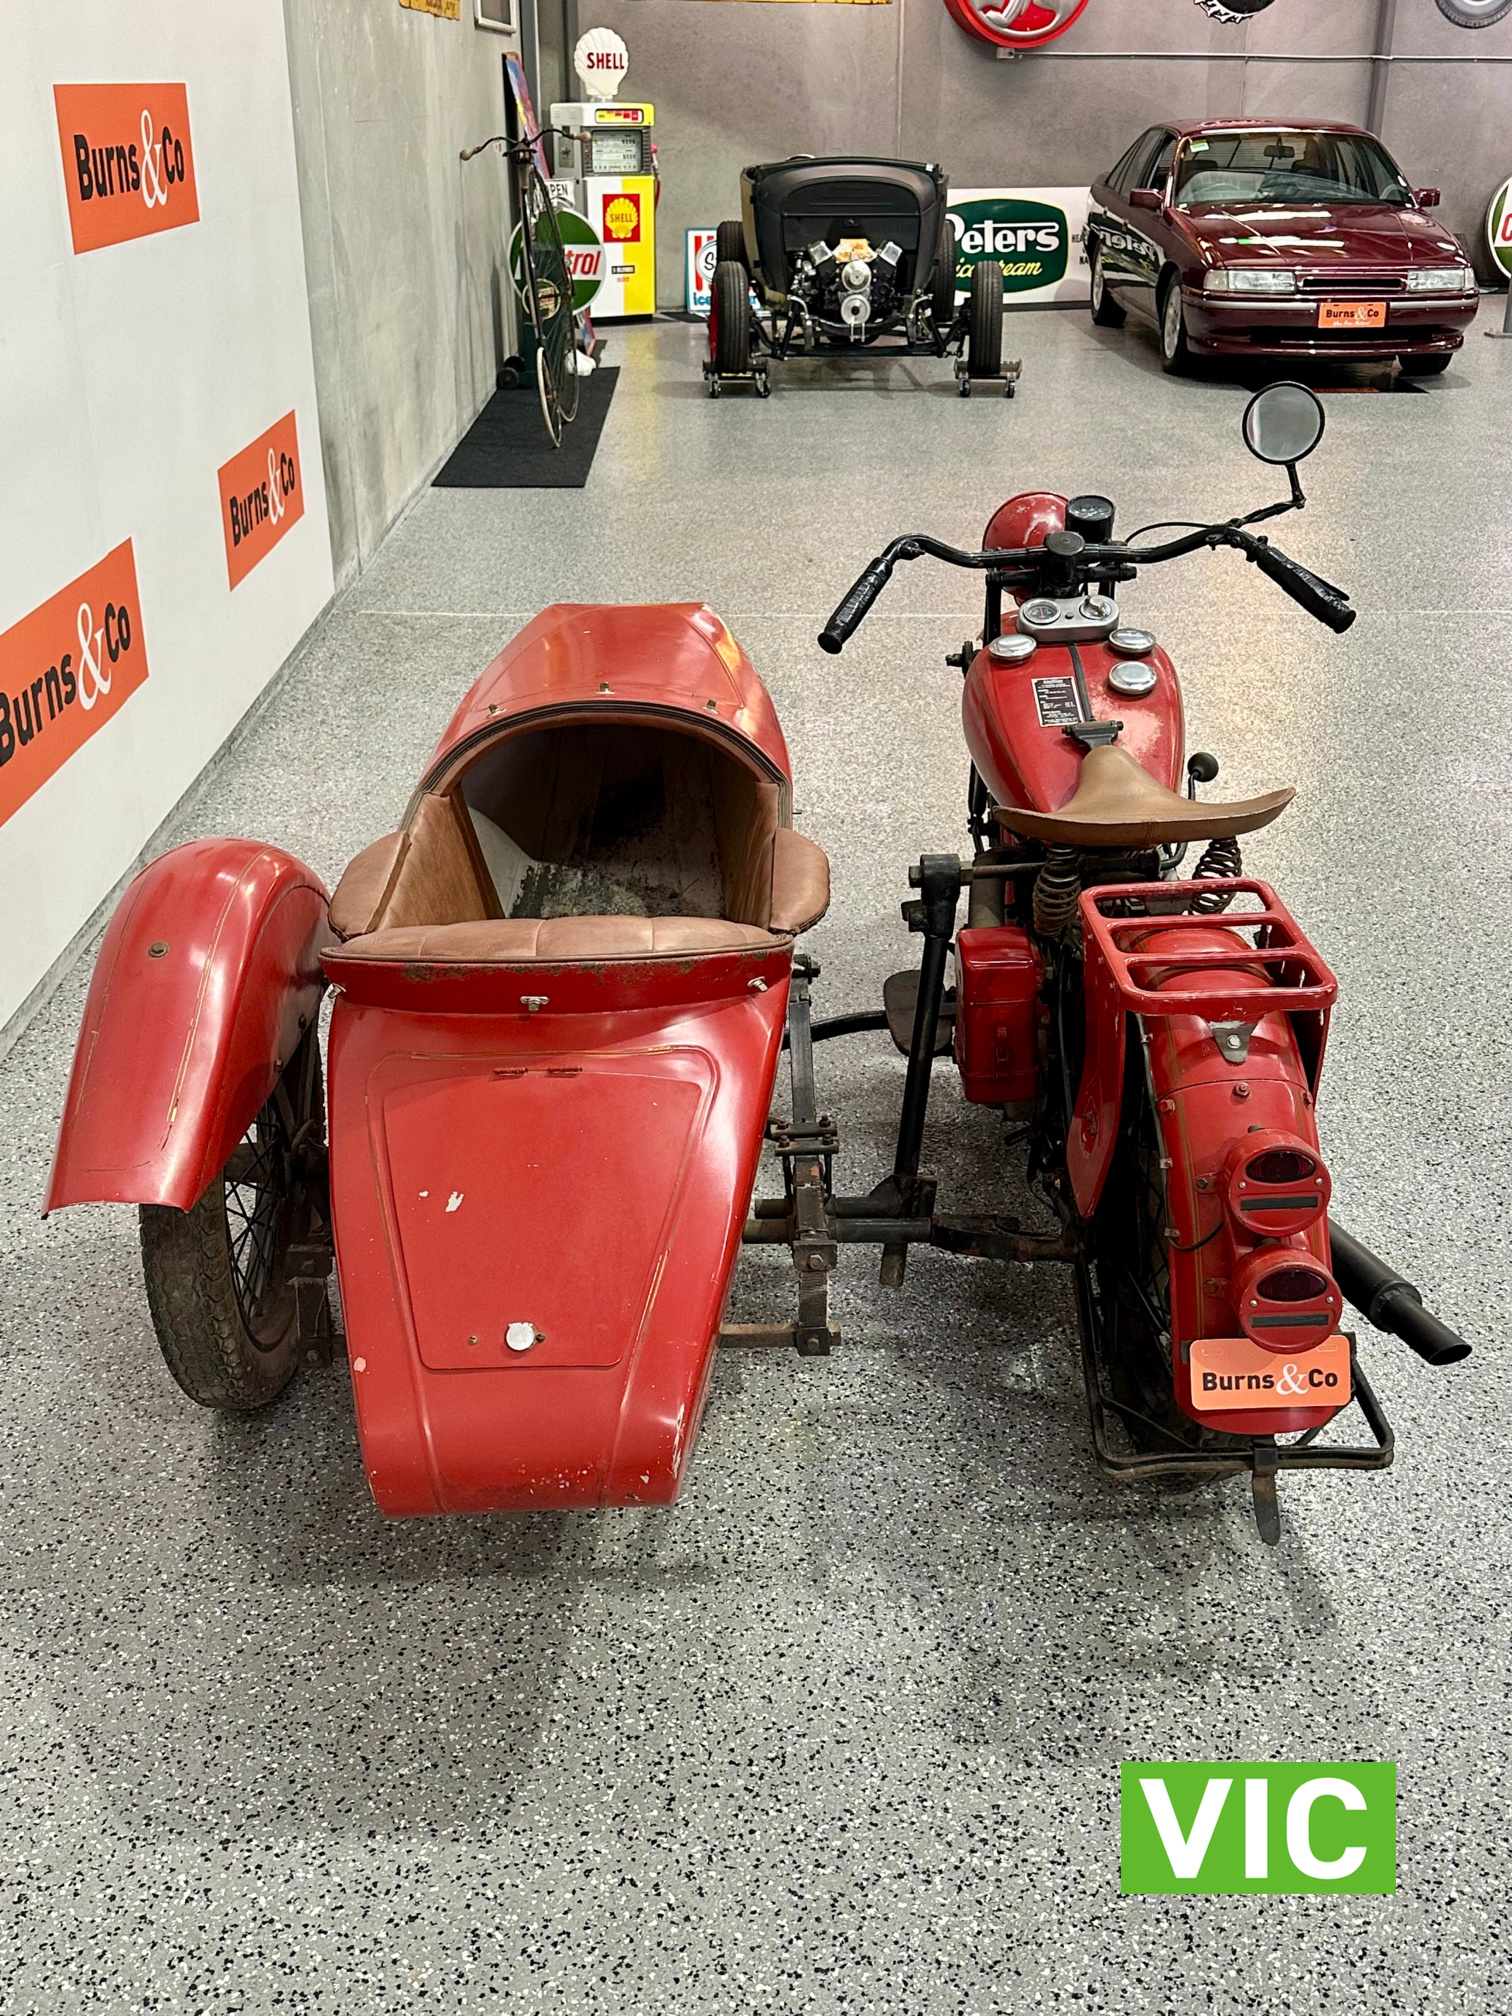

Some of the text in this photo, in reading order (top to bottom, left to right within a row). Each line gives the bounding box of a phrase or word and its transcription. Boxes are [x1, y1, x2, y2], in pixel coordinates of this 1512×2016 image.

[587, 52, 625, 69] SHELL
[73, 109, 185, 208] Burns&Co
[549, 183, 569, 196] PEN
[610, 213, 634, 223] SHELL
[1326, 306, 1379, 321] Burns&Co
[229, 447, 296, 548] Burns&Co
[1202, 1363, 1338, 1395] Burns&Co
